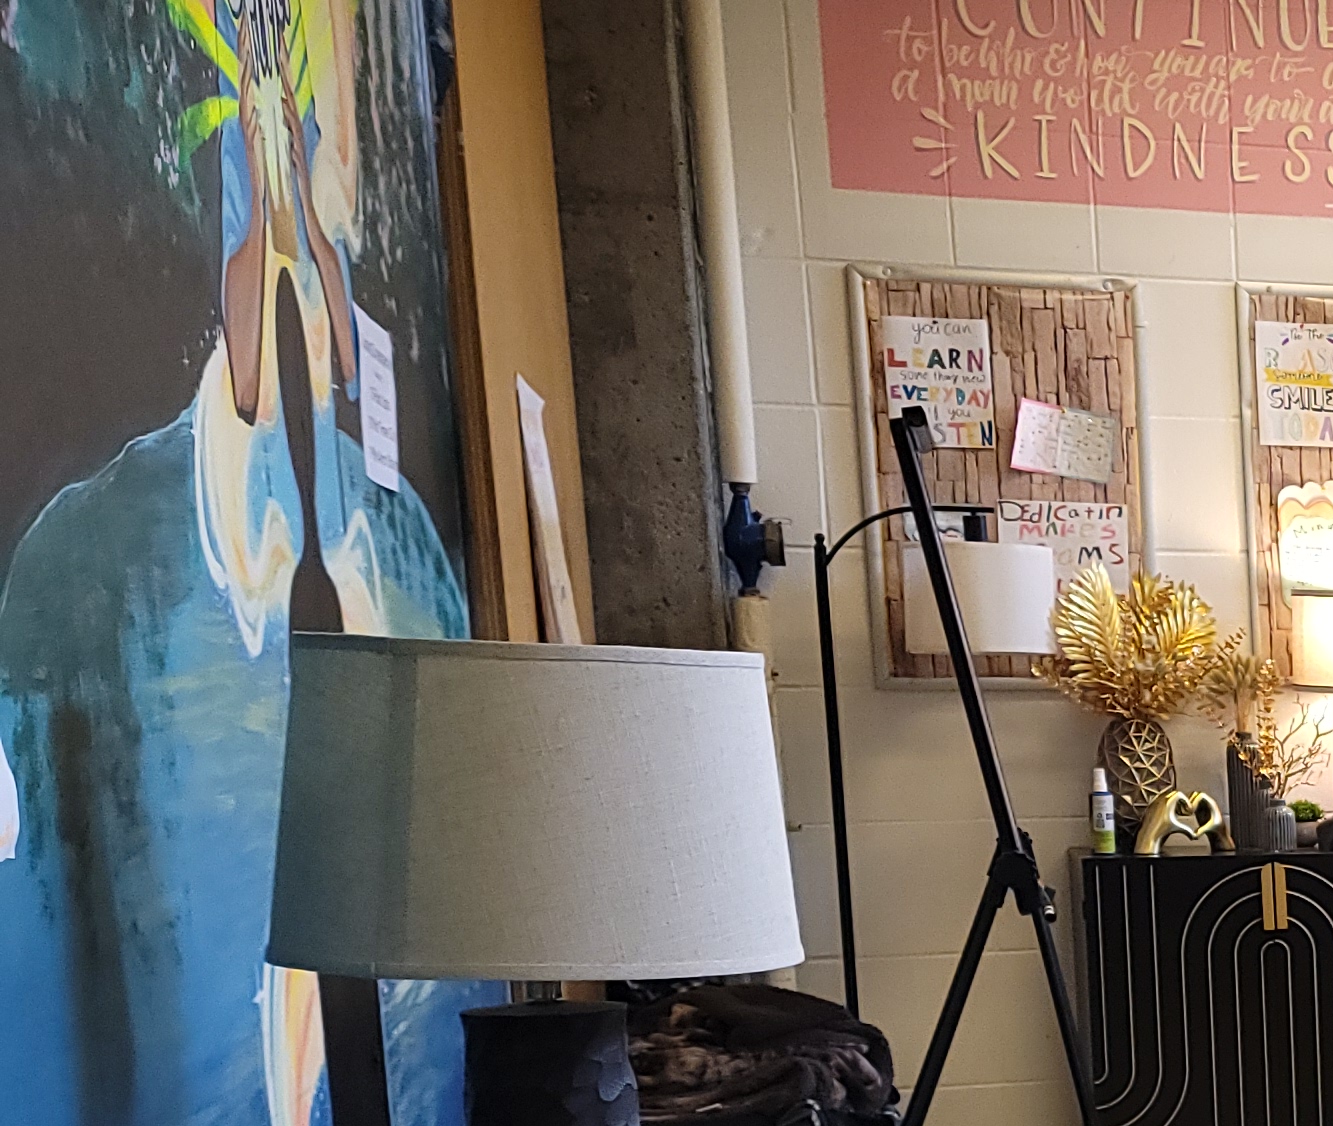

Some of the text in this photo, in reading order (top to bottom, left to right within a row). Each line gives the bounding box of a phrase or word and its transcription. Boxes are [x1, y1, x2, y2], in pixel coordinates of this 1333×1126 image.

[884, 15, 936, 62] to
[941, 18, 976, 67] be
[1043, 41, 1071, 77] &
[1144, 48, 1206, 90] you
[1258, 51, 1314, 82] to
[891, 69, 919, 101] a
[1154, 77, 1229, 125] with
[912, 322, 972, 344] you can
[886, 347, 984, 373] LEARN
[890, 384, 991, 410] EVERYDAY
[948, 408, 970, 420] you
[933, 420, 993, 446] STEN
